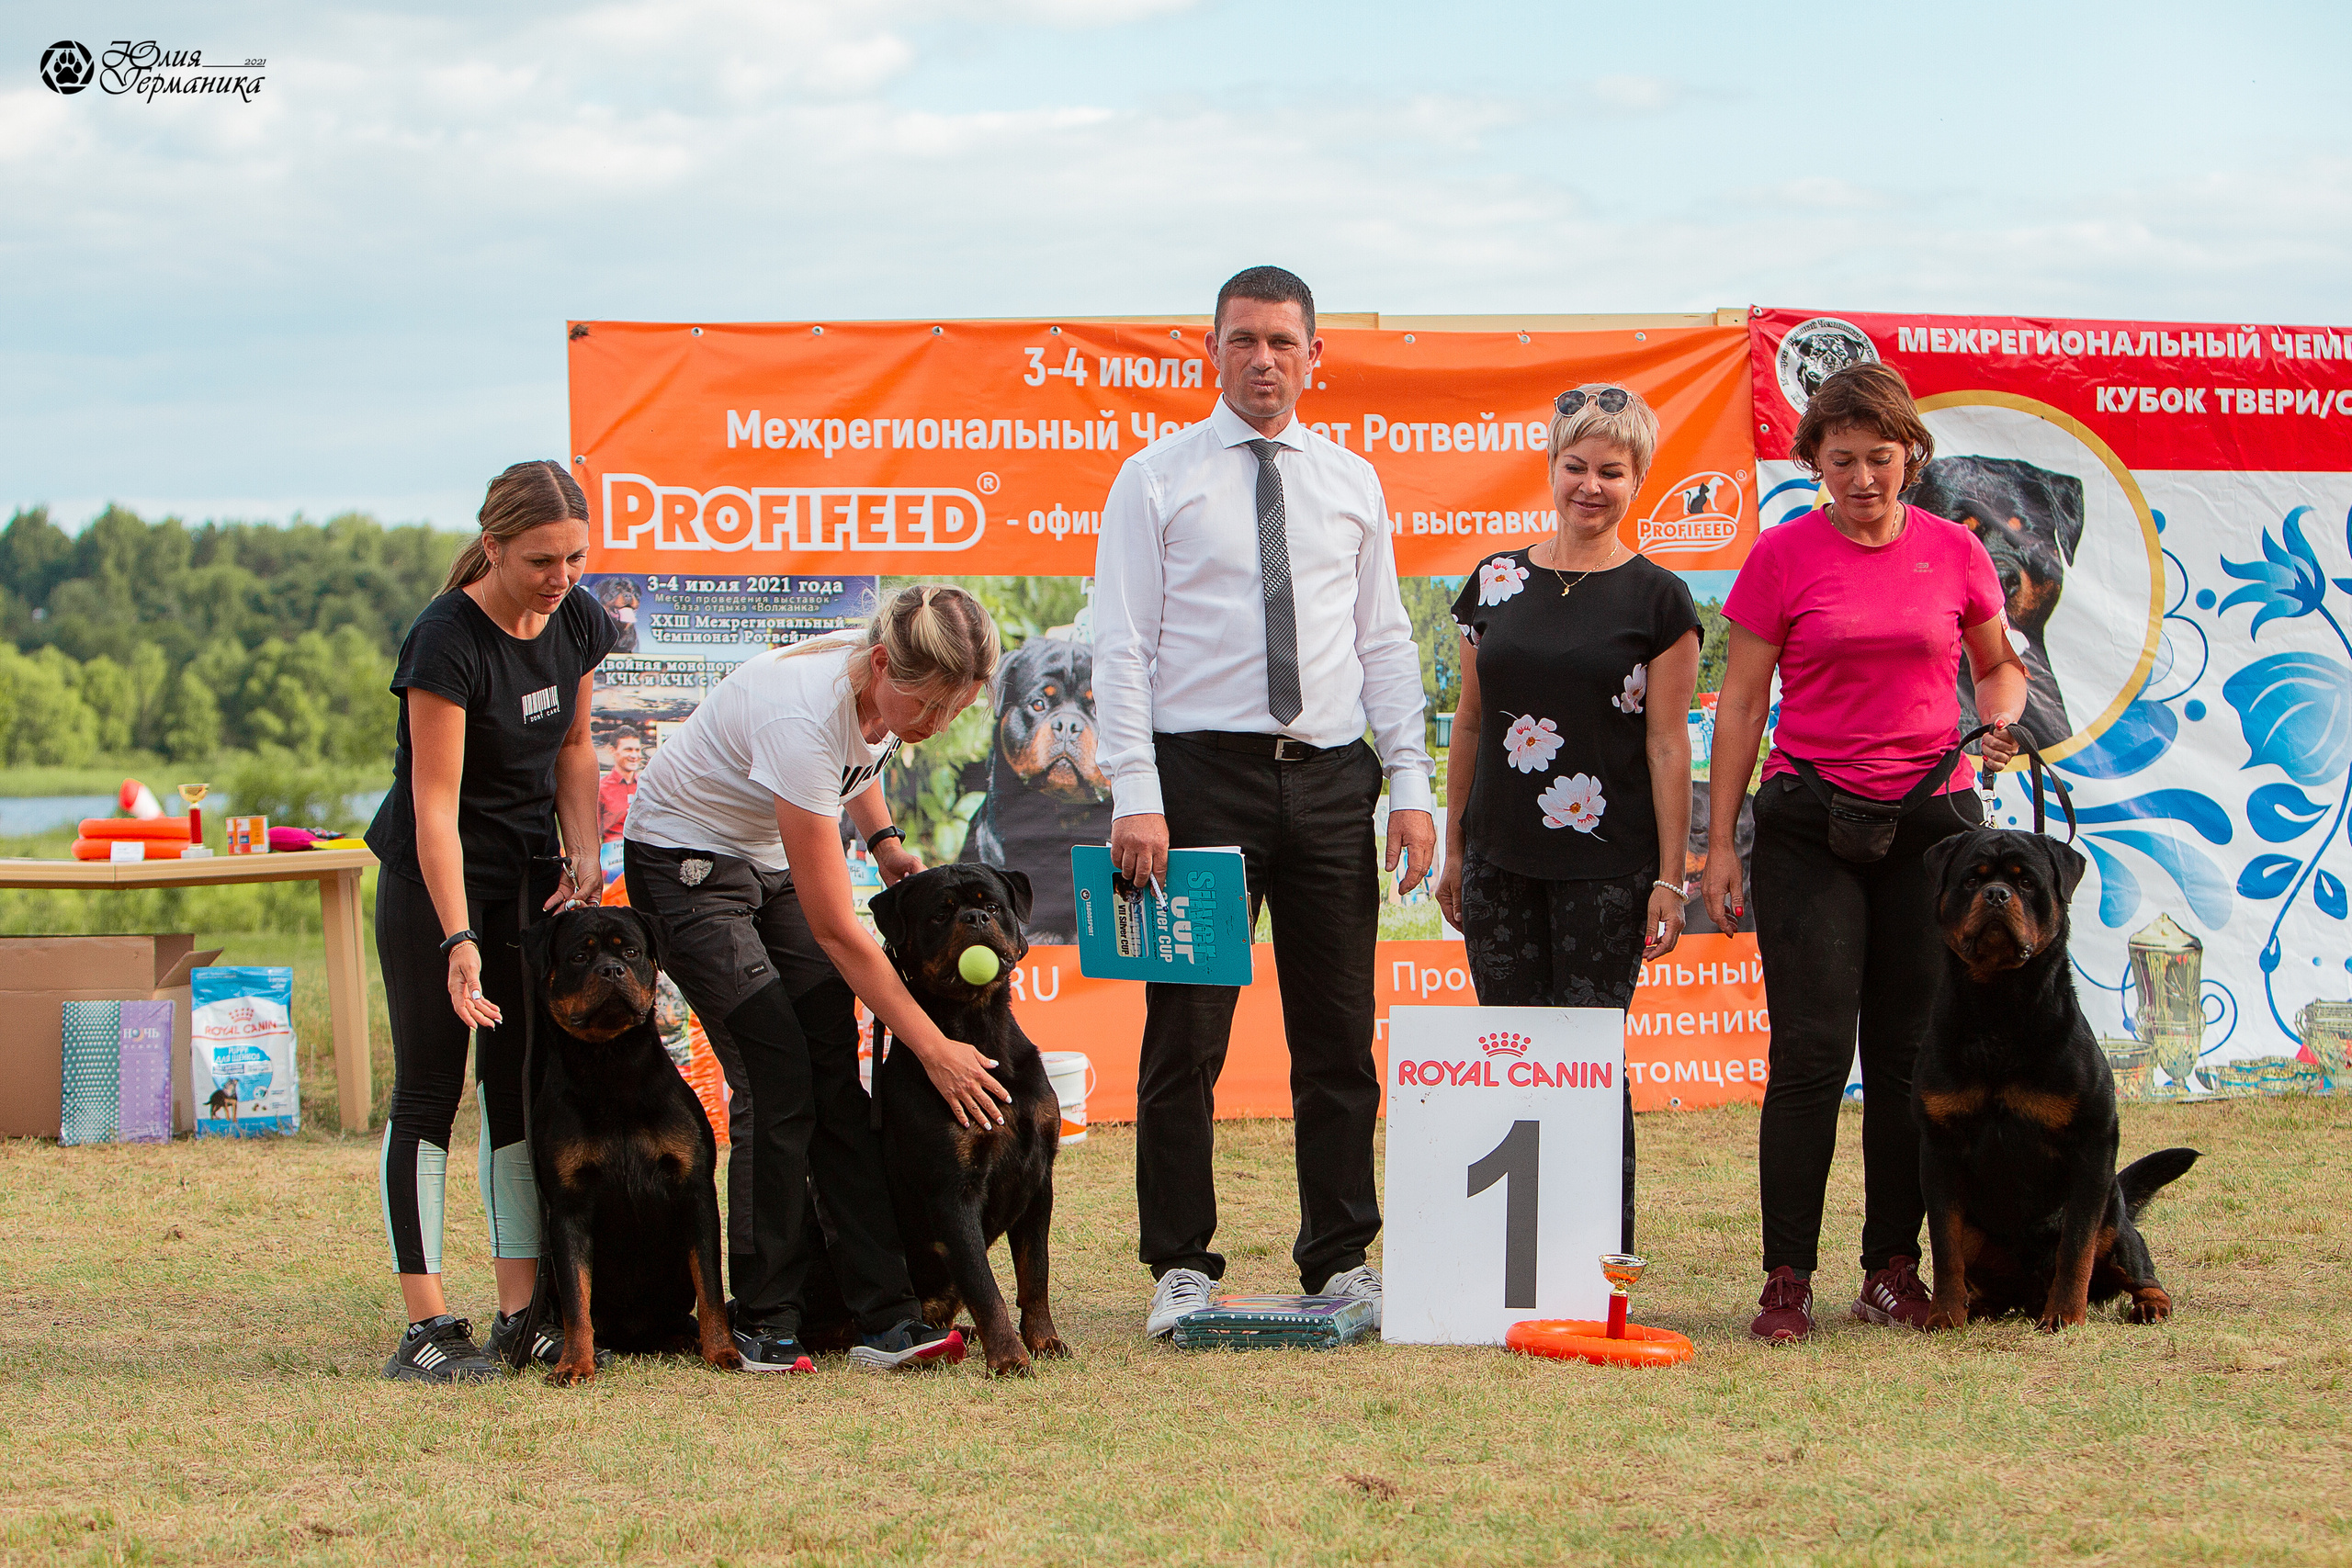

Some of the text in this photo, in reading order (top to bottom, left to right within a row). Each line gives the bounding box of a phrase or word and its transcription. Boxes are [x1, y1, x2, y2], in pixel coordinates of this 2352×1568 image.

[1898, 325, 2261, 358] МЕЖРЕГИОНАЛЬНЫЙ
[1023, 346, 1087, 387] 3-4
[1099, 356, 1203, 388] июля
[2097, 386, 2207, 414] КУБОК
[726, 409, 1119, 458] Межрегиональный
[1363, 412, 1548, 452] Ротвейле
[602, 472, 986, 551] PROFIFEED
[1028, 502, 1104, 542] офиц
[1413, 510, 1558, 535] выставки
[1638, 519, 1738, 540] PROFIFEED
[647, 576, 844, 596] 3-4 июля 2021 года
[655, 593, 691, 603] Место
[695, 595, 768, 606] проведения
[774, 596, 830, 604] выставок
[673, 602, 820, 614] база отдыха «Волжанка»
[650, 614, 845, 632] XXIII Межрегиональный
[651, 628, 820, 644] Чемпионат Ротвейле
[605, 673, 641, 685] КЧК
[645, 677, 655, 685] и
[660, 674, 695, 686] КЧК
[666, 661, 744, 675] монопоро
[1119, 916, 1127, 938] Silver
[1121, 940, 1130, 955] CUP
[1159, 935, 1173, 963] CUP
[1393, 962, 1476, 999] Про
[205, 1020, 277, 1036] ROYAL CANIN
[1627, 1009, 1770, 1036] млению
[1398, 1060, 1613, 1089] ROYAL CANIN
[1630, 1058, 1767, 1088] томцев
[1467, 1120, 1541, 1309] 1
